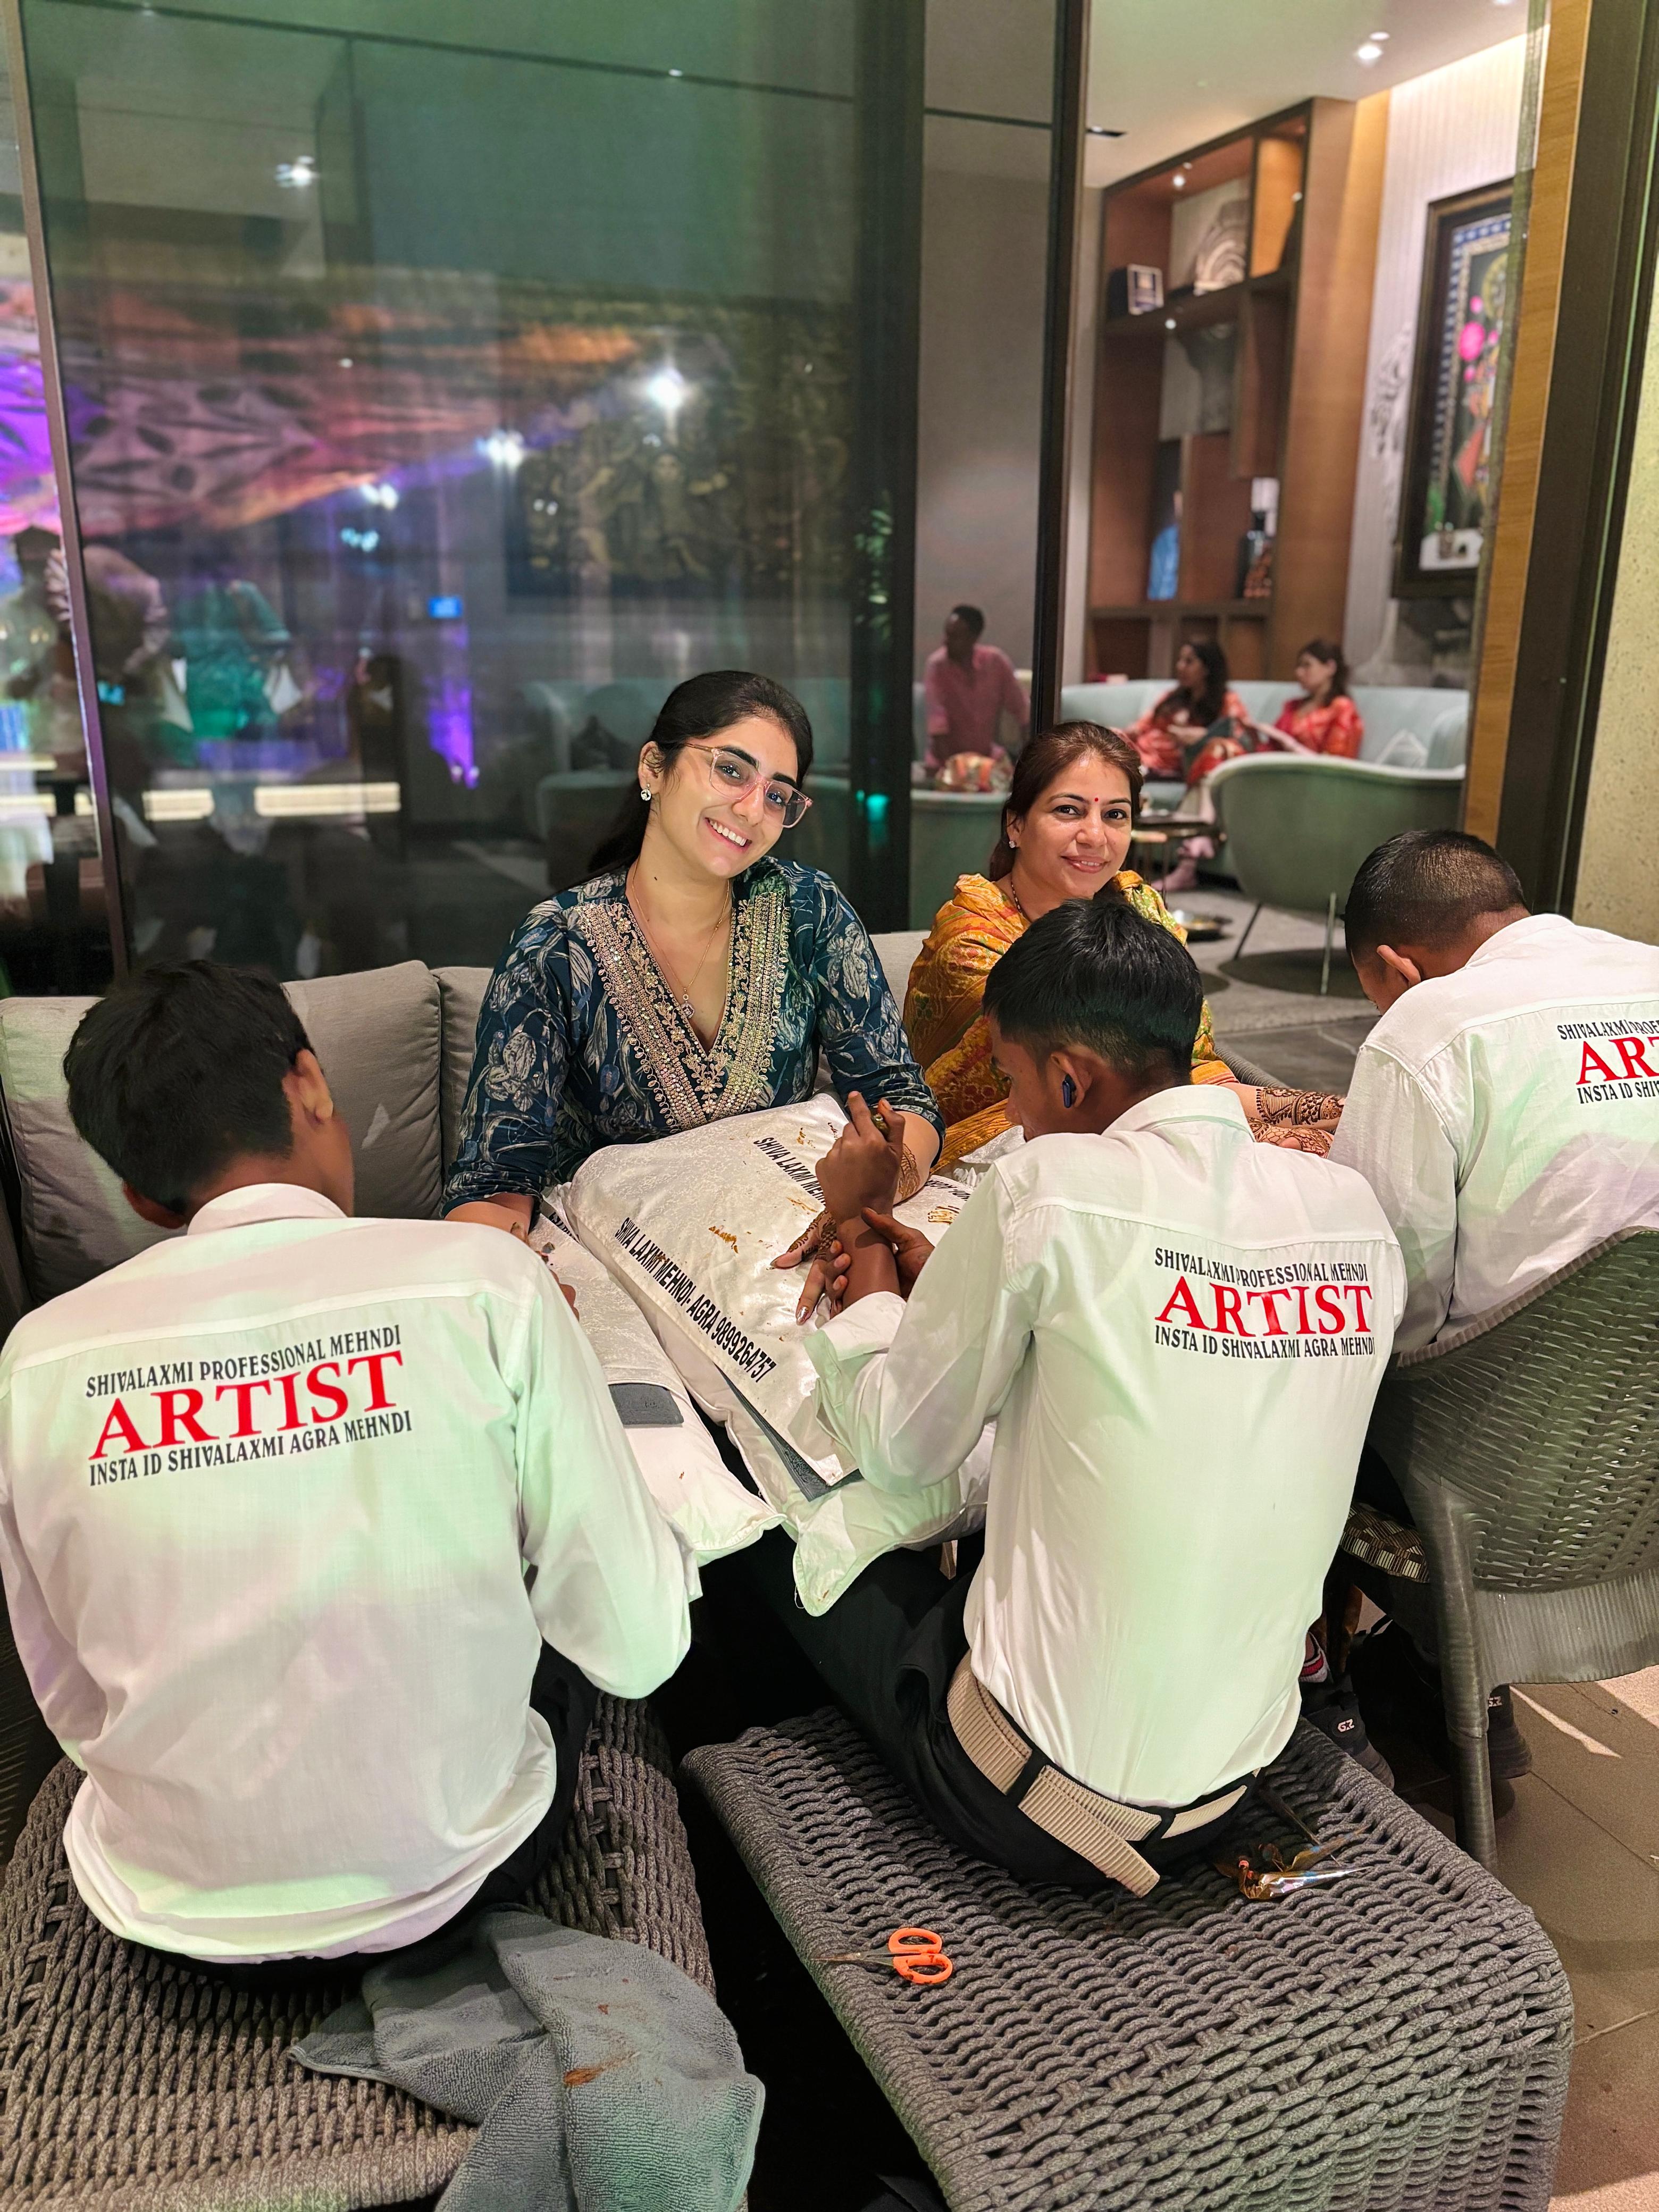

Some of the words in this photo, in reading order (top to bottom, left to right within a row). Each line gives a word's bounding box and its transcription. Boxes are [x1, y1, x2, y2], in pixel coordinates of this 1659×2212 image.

[1557, 1019, 1633, 1040] SHIVALAXMI
[1577, 1084, 1619, 1104] INSTA
[1618, 1083, 1633, 1099] ID
[753, 1137, 791, 1160] SHIVA
[776, 1157, 816, 1182] LAXMI
[1154, 1247, 1235, 1284] SHIVALAXMI
[1236, 1263, 1329, 1288] PROFESSIONAL
[1331, 1263, 1368, 1282] MEHNDI
[615, 1217, 640, 1249] SHIVA
[629, 1234, 668, 1273] LAXMI
[686, 1294, 721, 1335] AGRA
[711, 1317, 777, 1383] 9899264757
[1154, 1276, 1372, 1337] ARTIST
[86, 1361, 194, 1397] SHIVALAXMI
[199, 1338, 326, 1381] PROFESSIONAL
[330, 1325, 401, 1357] MEHNDI
[1155, 1325, 1199, 1352] INSTA
[1202, 1335, 1218, 1355] ID
[1222, 1337, 1301, 1359] SHIVALAXMI
[1304, 1338, 1338, 1357] AGRA
[1341, 1337, 1375, 1355] MEHNDI
[88, 1350, 403, 1460] ARTIST
[89, 1456, 139, 1486] INSTA
[144, 1454, 161, 1476] ID
[168, 1435, 284, 1472] SHIVALAXMI
[289, 1425, 341, 1455] AGRA
[344, 1410, 413, 1443] MEHNDI
